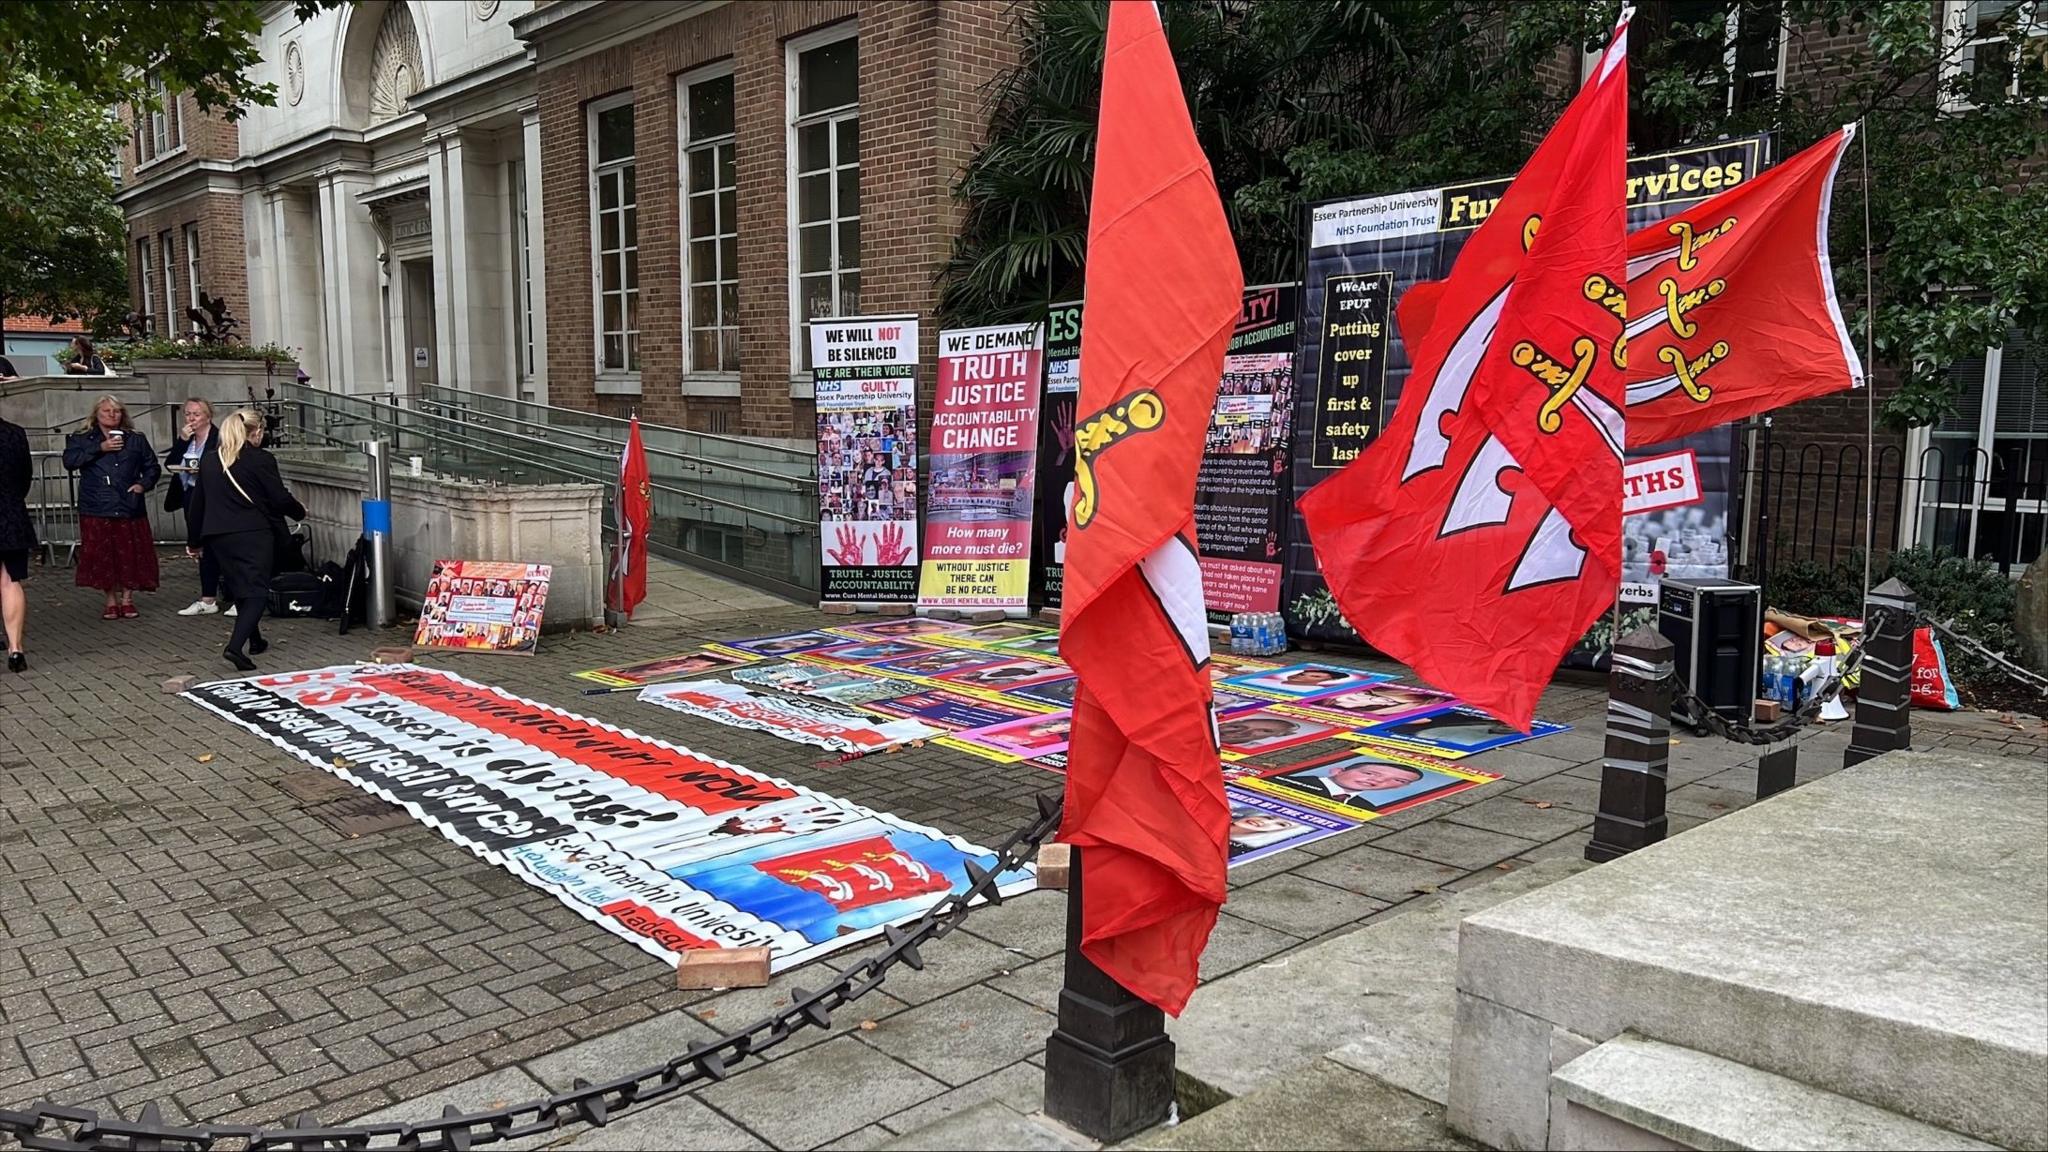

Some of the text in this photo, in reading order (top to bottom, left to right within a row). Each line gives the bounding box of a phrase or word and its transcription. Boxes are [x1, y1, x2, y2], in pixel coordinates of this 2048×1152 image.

[1626, 161, 1743, 199] rvices
[1314, 196, 1439, 222] Essex Partnership University
[1336, 215, 1436, 236] NHS Foundation Trust
[1336, 281, 1378, 293] #WeAre
[1239, 295, 1272, 324] LTY
[1340, 298, 1372, 310] EPUT
[1048, 308, 1079, 341] ES
[1329, 321, 1381, 337] Putting
[826, 327, 901, 343] WE WILL NOT
[948, 330, 1034, 351] WE DEMAND
[828, 347, 896, 361] BE SILENCED
[1334, 349, 1373, 362] cover
[817, 366, 911, 378] WE ARE THEIR VOICE
[950, 352, 1027, 381] TRUTH
[1049, 361, 1068, 374] NHS
[816, 381, 841, 391] NHS
[861, 381, 899, 392] GUILTY
[1343, 375, 1359, 389] up
[836, 392, 876, 401] Partnership
[877, 391, 912, 400] University
[944, 382, 1026, 406] JUSTICE
[1327, 396, 1372, 412] first &
[933, 408, 1036, 426] ACCOUNTABILITY
[1325, 422, 1370, 439] safety
[943, 426, 1018, 449] CHANGE
[1332, 446, 1360, 461] last
[1248, 459, 1268, 468] learning
[1245, 488, 1265, 496] highest
[1210, 504, 1227, 512] should
[1229, 505, 1241, 513] have
[1242, 507, 1268, 515] prompted
[1251, 517, 1268, 525] senior
[947, 527, 1009, 540] How many
[1227, 524, 1240, 532] Trust
[1223, 534, 1248, 544] delivering
[931, 542, 1022, 554] more must die?
[936, 563, 1009, 571] WITHOUT JUSTICE
[1045, 567, 1064, 578] TRU
[1229, 564, 1246, 572] asked
[1247, 566, 1263, 574] about
[1264, 568, 1276, 576] why
[829, 570, 863, 578] TRUTH
[871, 570, 913, 579] JUSTICE
[950, 574, 994, 583] THERE CAN
[829, 581, 915, 590] ACCOUNTABILITY
[946, 586, 997, 594] BE NO PEACE
[1045, 581, 1063, 591] ACC
[1229, 584, 1240, 592] why
[1619, 585, 1653, 598] verbs
[1222, 592, 1245, 600] continue
[1220, 600, 1233, 608] right
[1209, 612, 1231, 621] Mental
[1916, 667, 1938, 679] for
[438, 738, 494, 758] is
[485, 759, 678, 828] dying!
[1260, 800, 1342, 829] BY THE STATE
